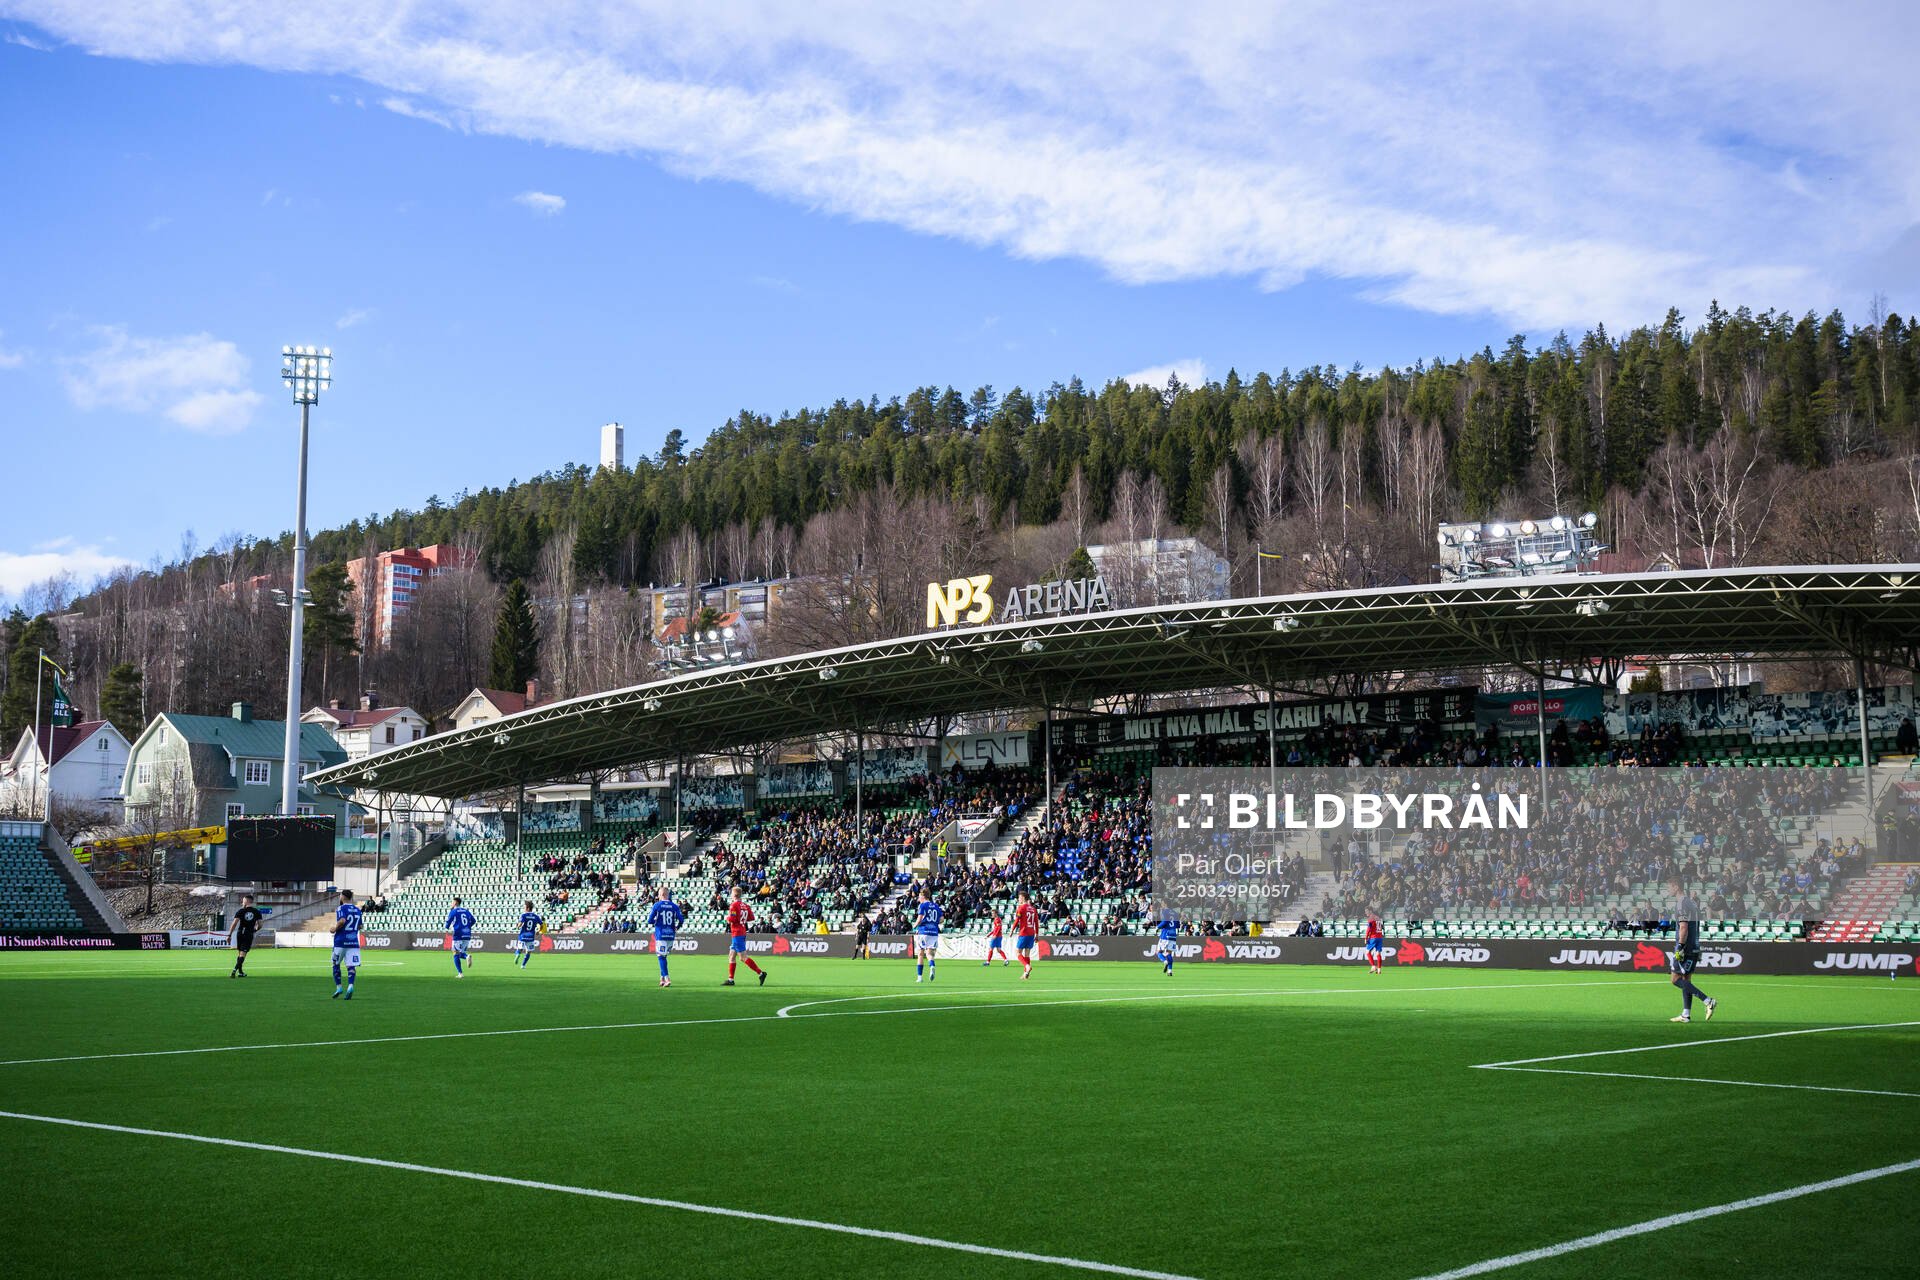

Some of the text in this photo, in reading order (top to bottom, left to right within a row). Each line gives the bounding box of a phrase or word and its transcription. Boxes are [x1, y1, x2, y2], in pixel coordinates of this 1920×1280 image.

[927, 574, 1110, 628] NP3 ARENA
[1513, 702, 1560, 712] PORTLLO
[1124, 717, 1163, 741] MOT
[1166, 714, 1202, 738] NYA
[945, 735, 1025, 762] XLENT
[345, 914, 360, 931] 27
[461, 913, 468, 926] 6
[660, 910, 673, 926] 18
[926, 909, 938, 923] 30
[1026, 911, 1035, 925] 21
[526, 920, 533, 931] 9
[14, 935, 68, 947] Sundsvalls
[69, 937, 115, 947] centrum.
[366, 937, 391, 948] YARD
[412, 937, 444, 948] JUMP
[552, 939, 584, 950] YARD
[611, 940, 698, 951] JUMP ARD
[790, 941, 829, 953] YARD
[866, 942, 907, 954] UMP
[1050, 943, 1100, 956] YARD
[1226, 945, 1281, 959] YARD
[1424, 948, 1491, 962] YARD
[1549, 949, 1632, 965] JUMP
[1813, 953, 1913, 970] JUMP
